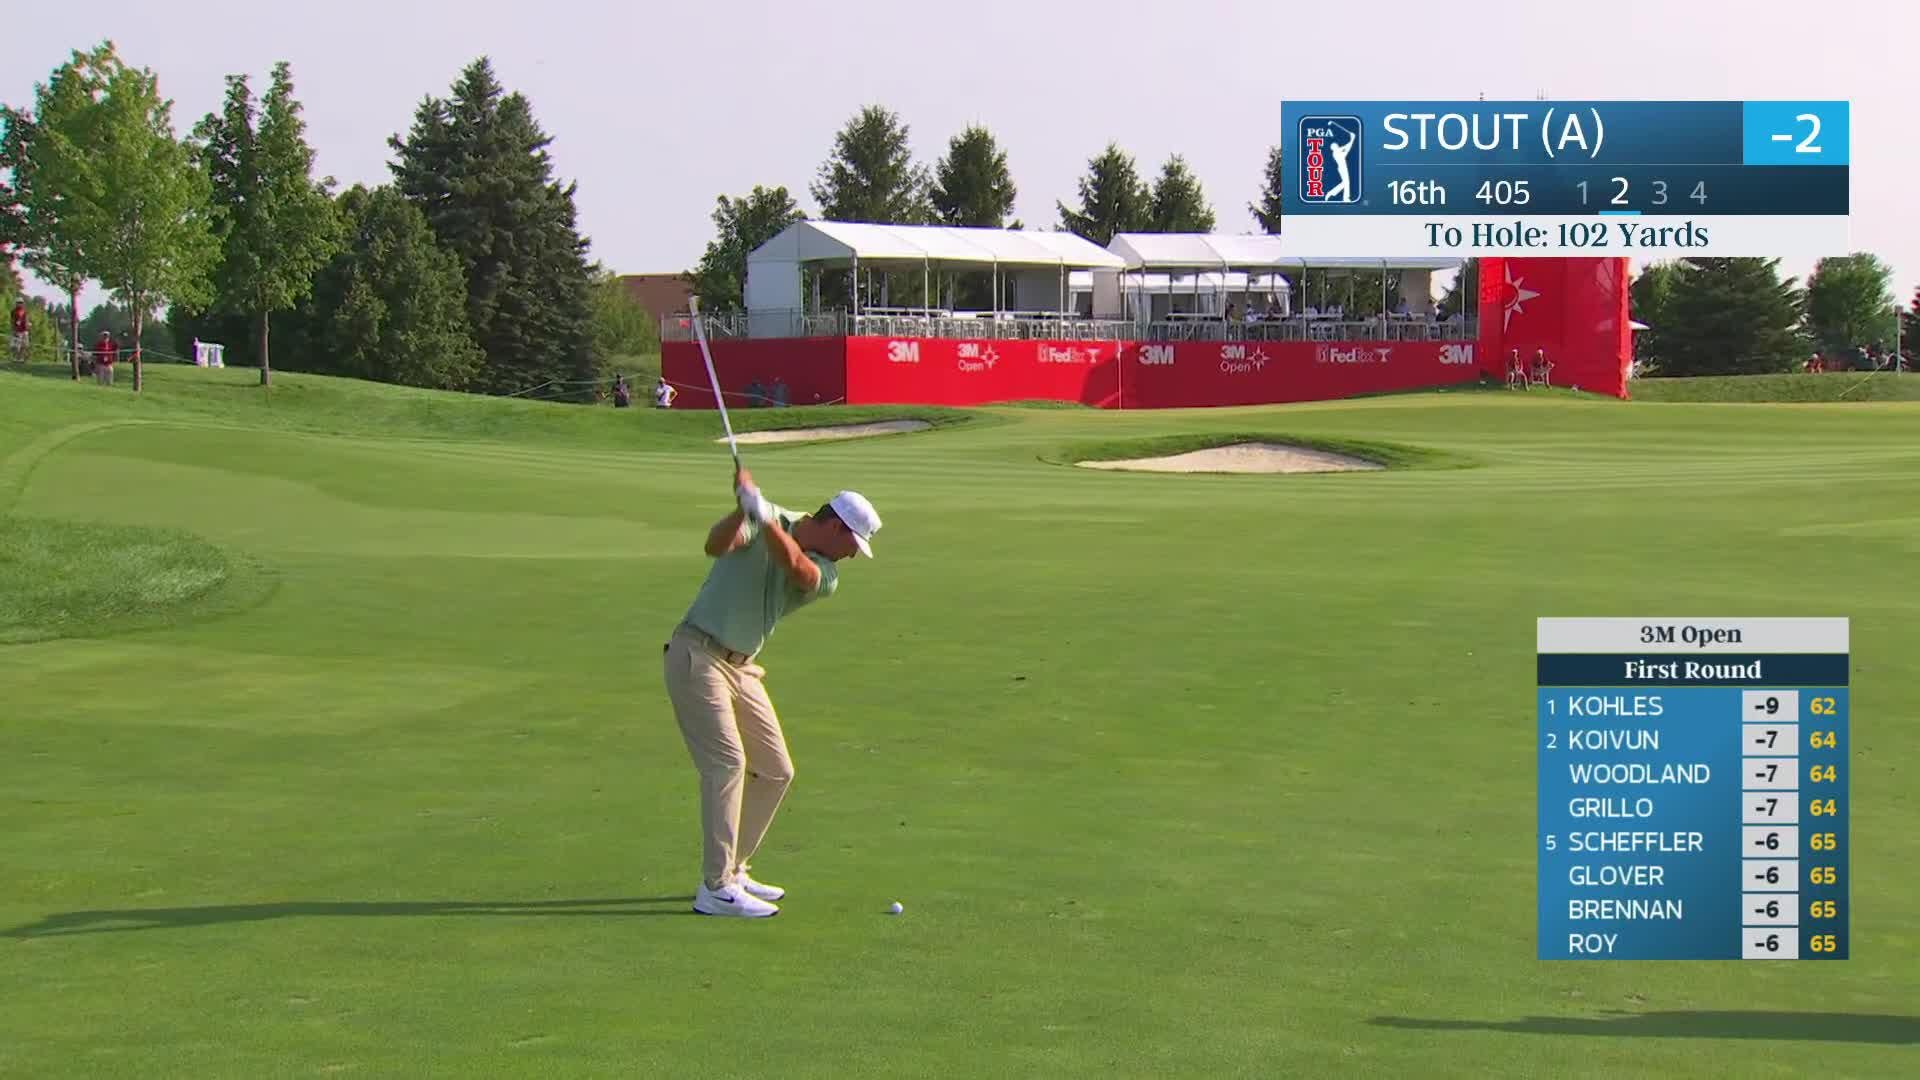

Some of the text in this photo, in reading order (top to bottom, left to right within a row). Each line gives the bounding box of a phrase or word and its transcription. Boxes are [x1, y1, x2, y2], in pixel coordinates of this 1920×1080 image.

[887, 341, 920, 363] 3M
[957, 343, 979, 358] 3M
[1139, 344, 1174, 365] 3M
[1220, 345, 1246, 360] 3M
[1438, 344, 1474, 365] 3M
[958, 359, 985, 372] Open
[1219, 360, 1252, 374] Open
